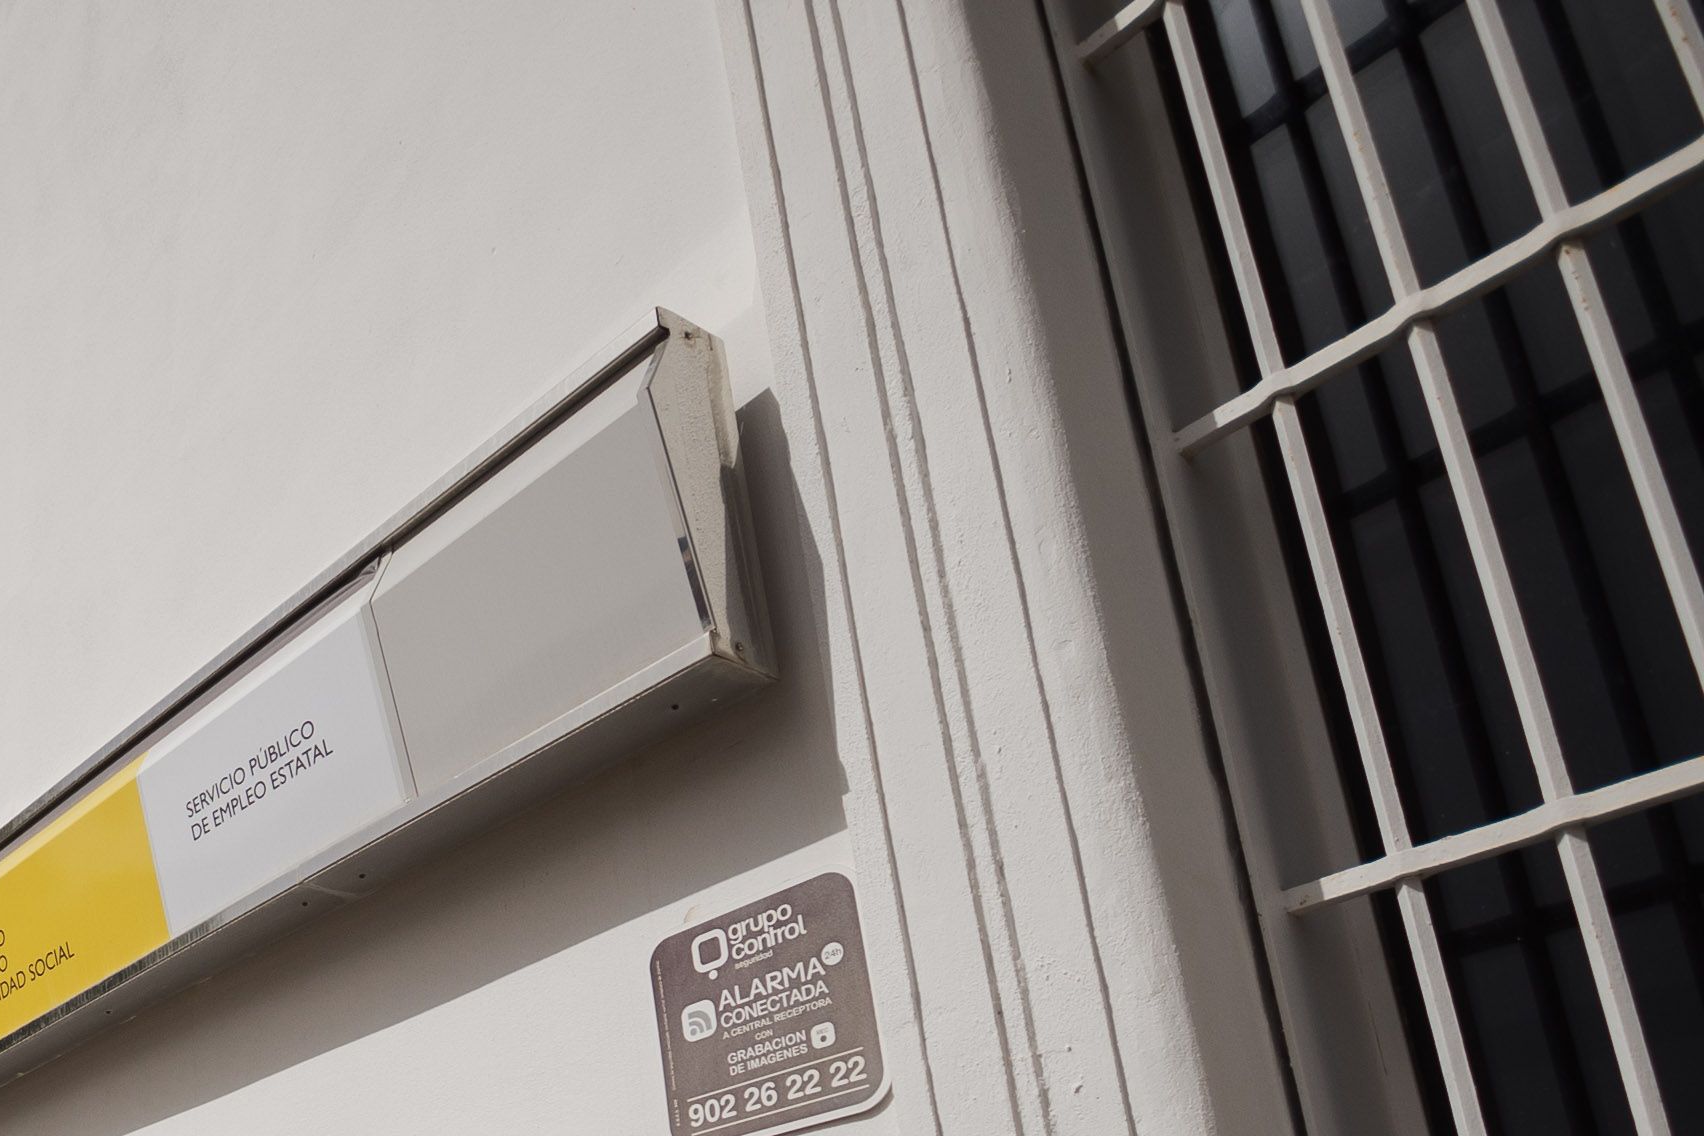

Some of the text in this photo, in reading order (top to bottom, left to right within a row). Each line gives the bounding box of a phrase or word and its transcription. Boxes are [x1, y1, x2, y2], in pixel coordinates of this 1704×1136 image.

[186, 721, 315, 818] SERVICIO PÚBLICO
[191, 739, 334, 841] DE EMPLEO ESTATAL
[728, 904, 792, 944] grupo
[731, 914, 807, 960] control
[28, 941, 75, 981] SOCIAL
[734, 949, 774, 970] seguridad
[718, 957, 826, 1012] ALARMA
[720, 980, 829, 1028] CONECTADA
[722, 997, 833, 1040] A CENTRAL RECEPTORA
[755, 1029, 774, 1041] CON
[727, 1029, 807, 1064] GRABACION
[729, 1043, 808, 1076] DE IMAGENES
[688, 1093, 737, 1127] 902
[744, 1081, 778, 1112] 26
[785, 1069, 822, 1100] 22
[829, 1055, 868, 1088] 22
